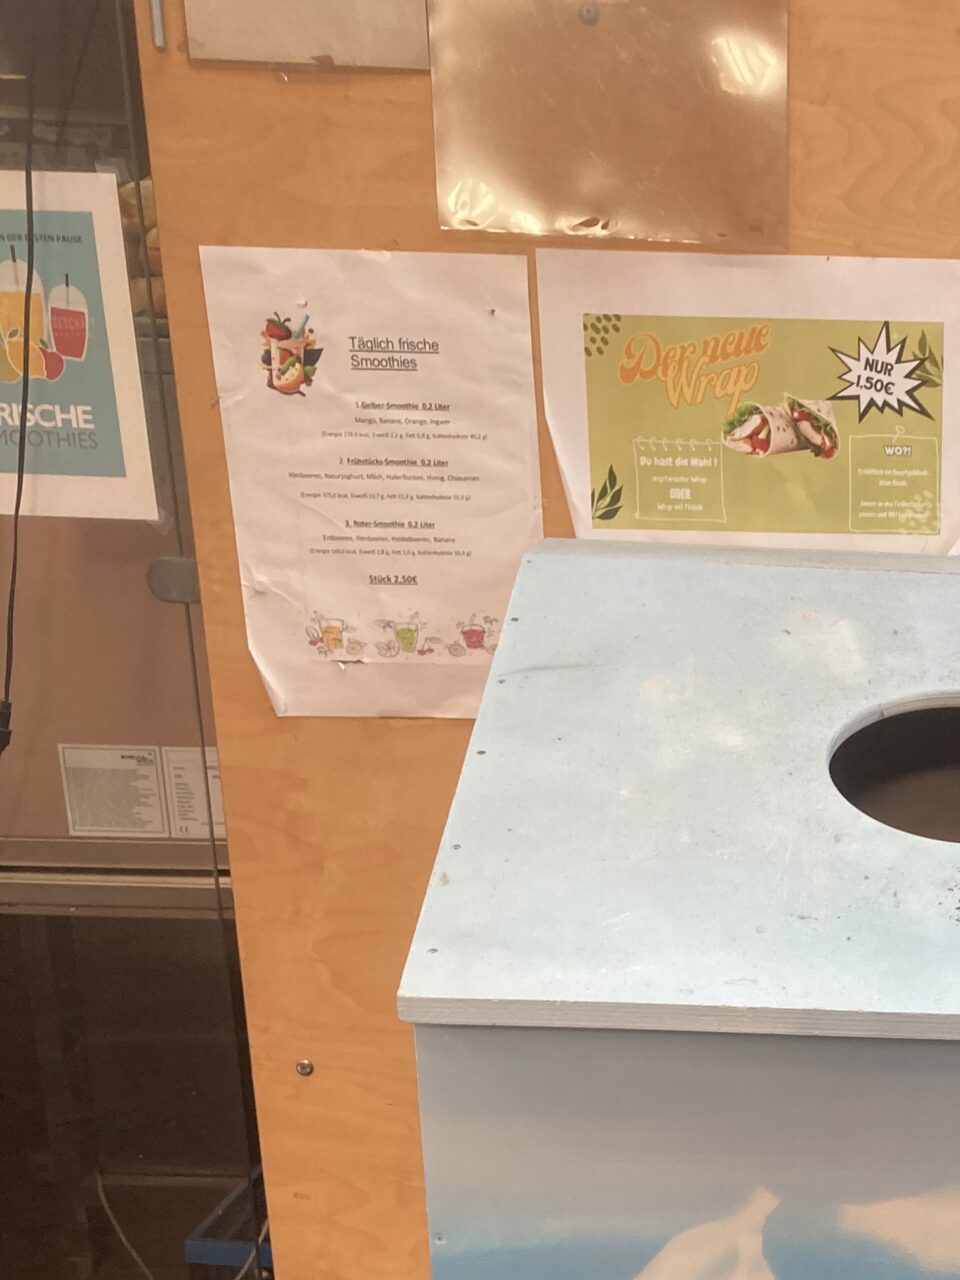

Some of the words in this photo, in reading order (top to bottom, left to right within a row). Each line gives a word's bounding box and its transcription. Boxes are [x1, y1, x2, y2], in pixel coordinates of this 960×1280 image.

[6, 233, 22, 242] DER
[25, 233, 54, 243] ESTEN
[56, 234, 82, 244] PAUSE
[348, 336, 394, 352] Täglich
[398, 337, 439, 353] frische
[618, 332, 697, 384] Der
[702, 323, 772, 363] neue
[350, 354, 418, 370] Smoothies
[864, 356, 894, 377] NUR
[664, 355, 760, 420] Wrap
[434, 402, 451, 411] Liter
[430, 418, 450, 426] Ingwer
[433, 459, 449, 467] Liter
[640, 456, 652, 466] Du
[653, 456, 673, 467] hast
[674, 457, 689, 467] die
[690, 457, 712, 467] Wahl
[368, 575, 392, 585] Stück
